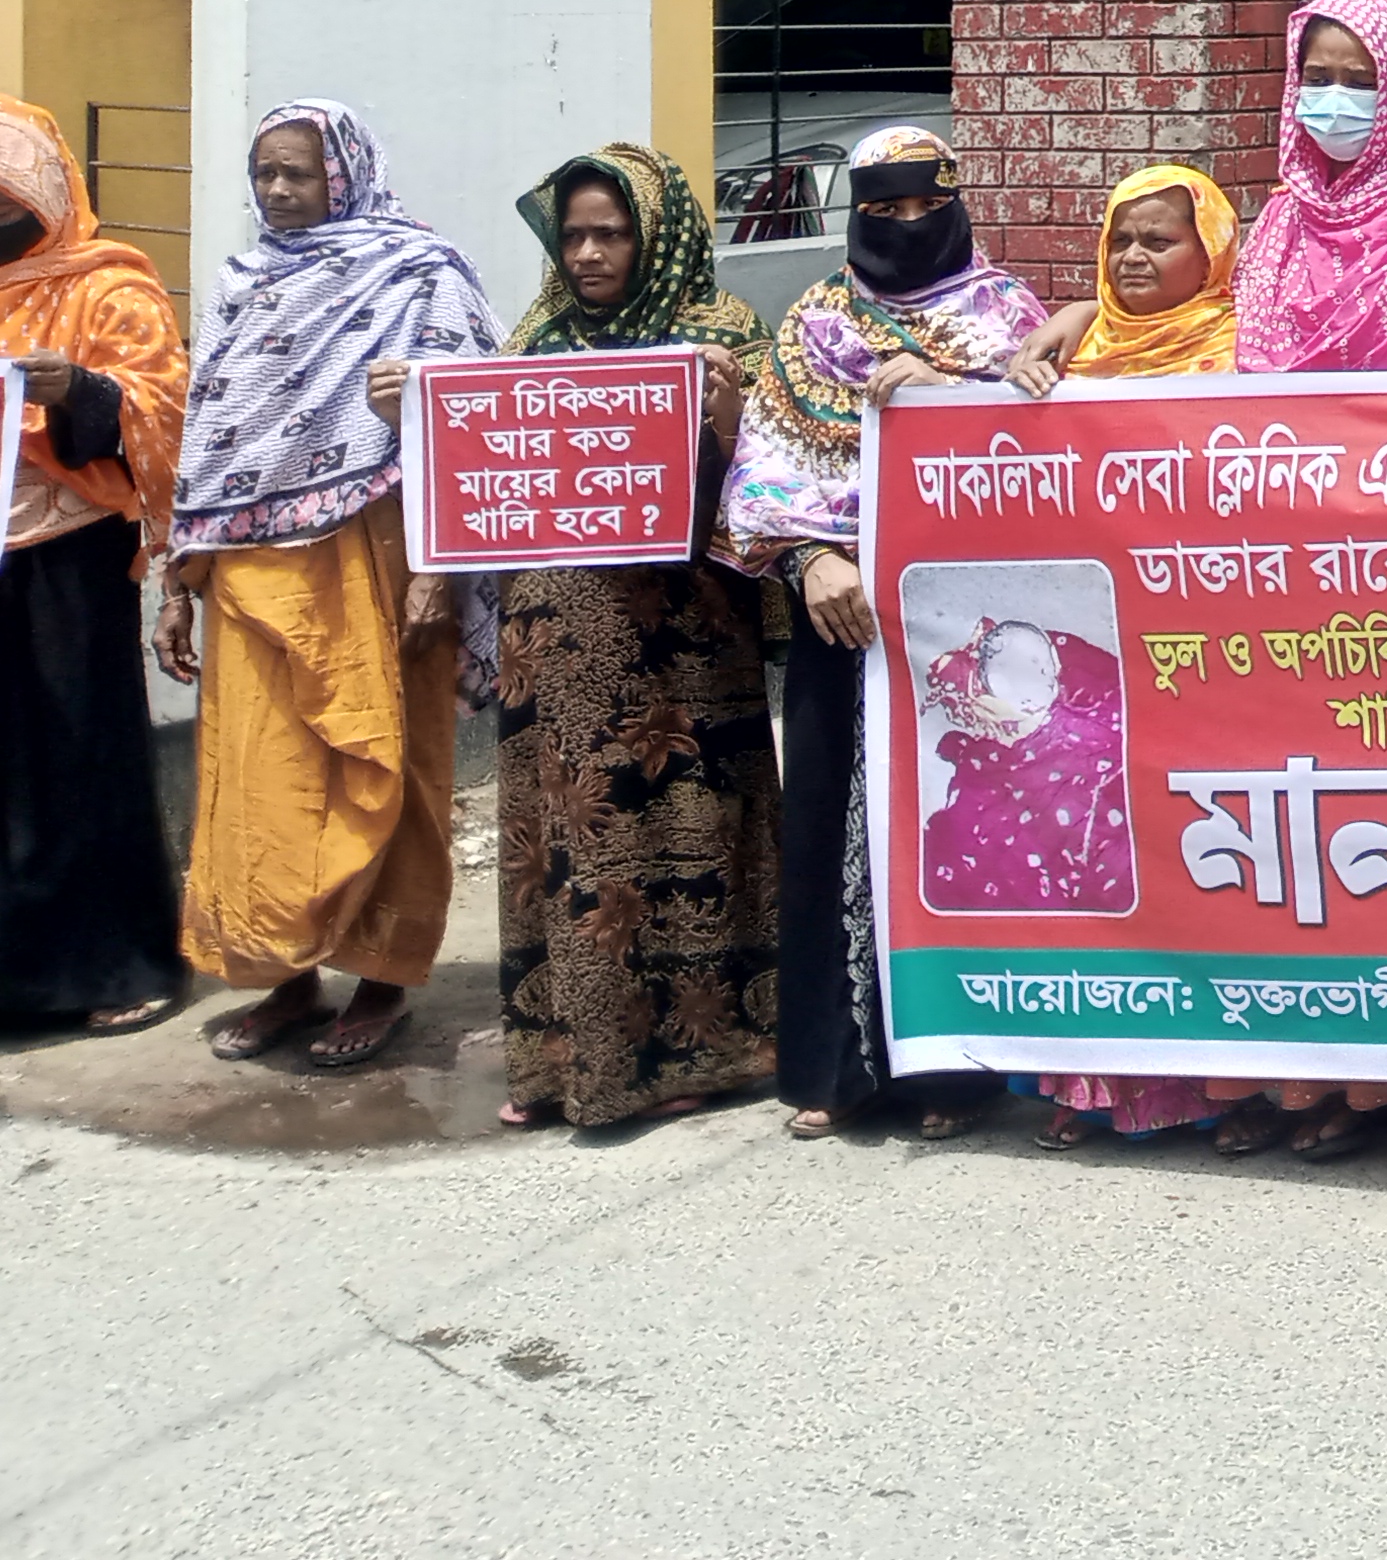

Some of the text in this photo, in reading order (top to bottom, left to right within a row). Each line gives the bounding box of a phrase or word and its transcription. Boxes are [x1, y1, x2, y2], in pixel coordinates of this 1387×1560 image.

[438, 377, 678, 431] ভুল চিকিৎসায়
[481, 426, 635, 460] আর কত
[454, 461, 667, 502] মায়ের কোল
[912, 431, 1082, 519] আকলিমা
[1096, 439, 1189, 514] সেবা
[1203, 419, 1349, 518] ক্লিনিক
[463, 496, 660, 541] খালি হবে ?
[1127, 538, 1294, 600] ডাক্তার
[1141, 634, 1208, 697] ভুল
[1219, 634, 1252, 675] ও
[958, 969, 1192, 1015] আয়োজনে:
